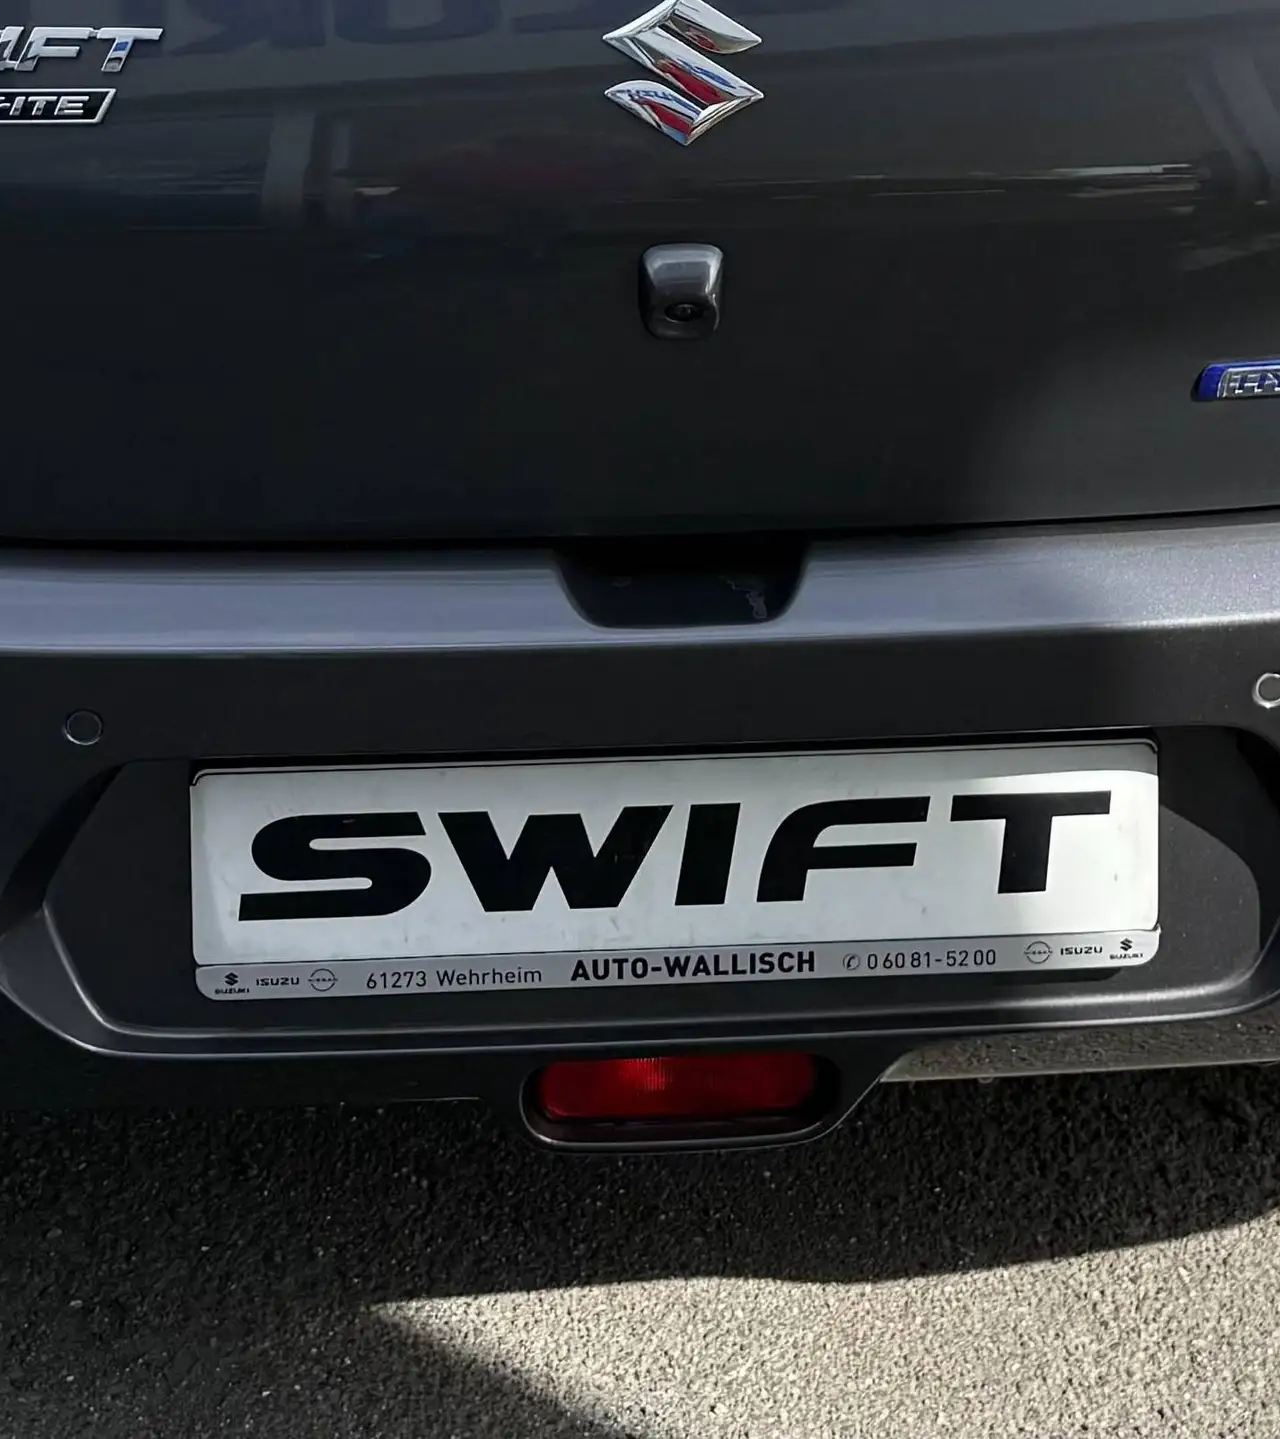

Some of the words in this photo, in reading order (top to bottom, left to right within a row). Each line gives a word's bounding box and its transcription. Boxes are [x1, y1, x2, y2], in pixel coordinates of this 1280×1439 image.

[238, 790, 1111, 921] SWIFT
[256, 977, 300, 986] ISUZU
[366, 970, 428, 990] 61273
[436, 966, 542, 987] Wehrheim
[570, 950, 816, 982] AUTO-WALLISCH
[1060, 946, 1103, 956] ISUZU
